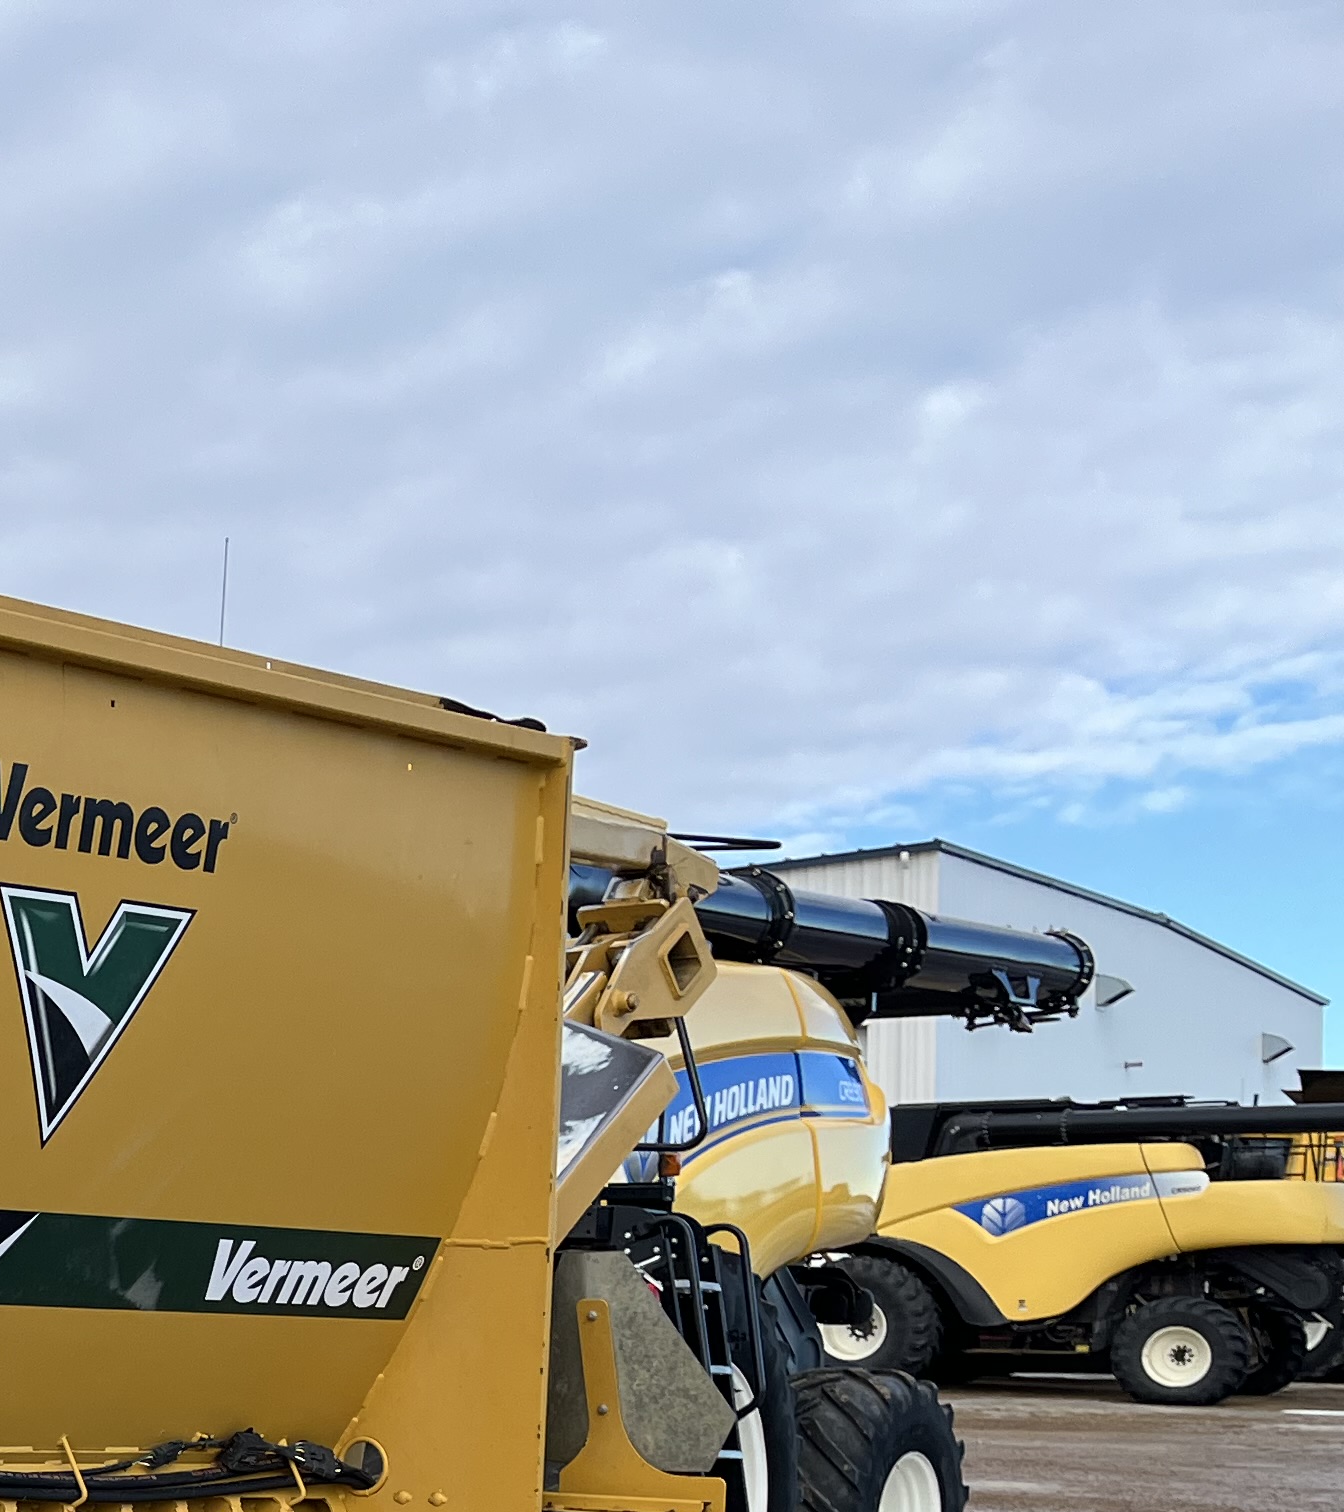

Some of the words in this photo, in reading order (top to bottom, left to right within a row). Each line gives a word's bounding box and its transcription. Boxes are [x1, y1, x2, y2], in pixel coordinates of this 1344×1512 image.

[712, 1074, 794, 1127] HOLLAND
[1046, 1194, 1085, 1217] New
[1087, 1182, 1152, 1207] Holland
[204, 1238, 410, 1309] Vermeer
